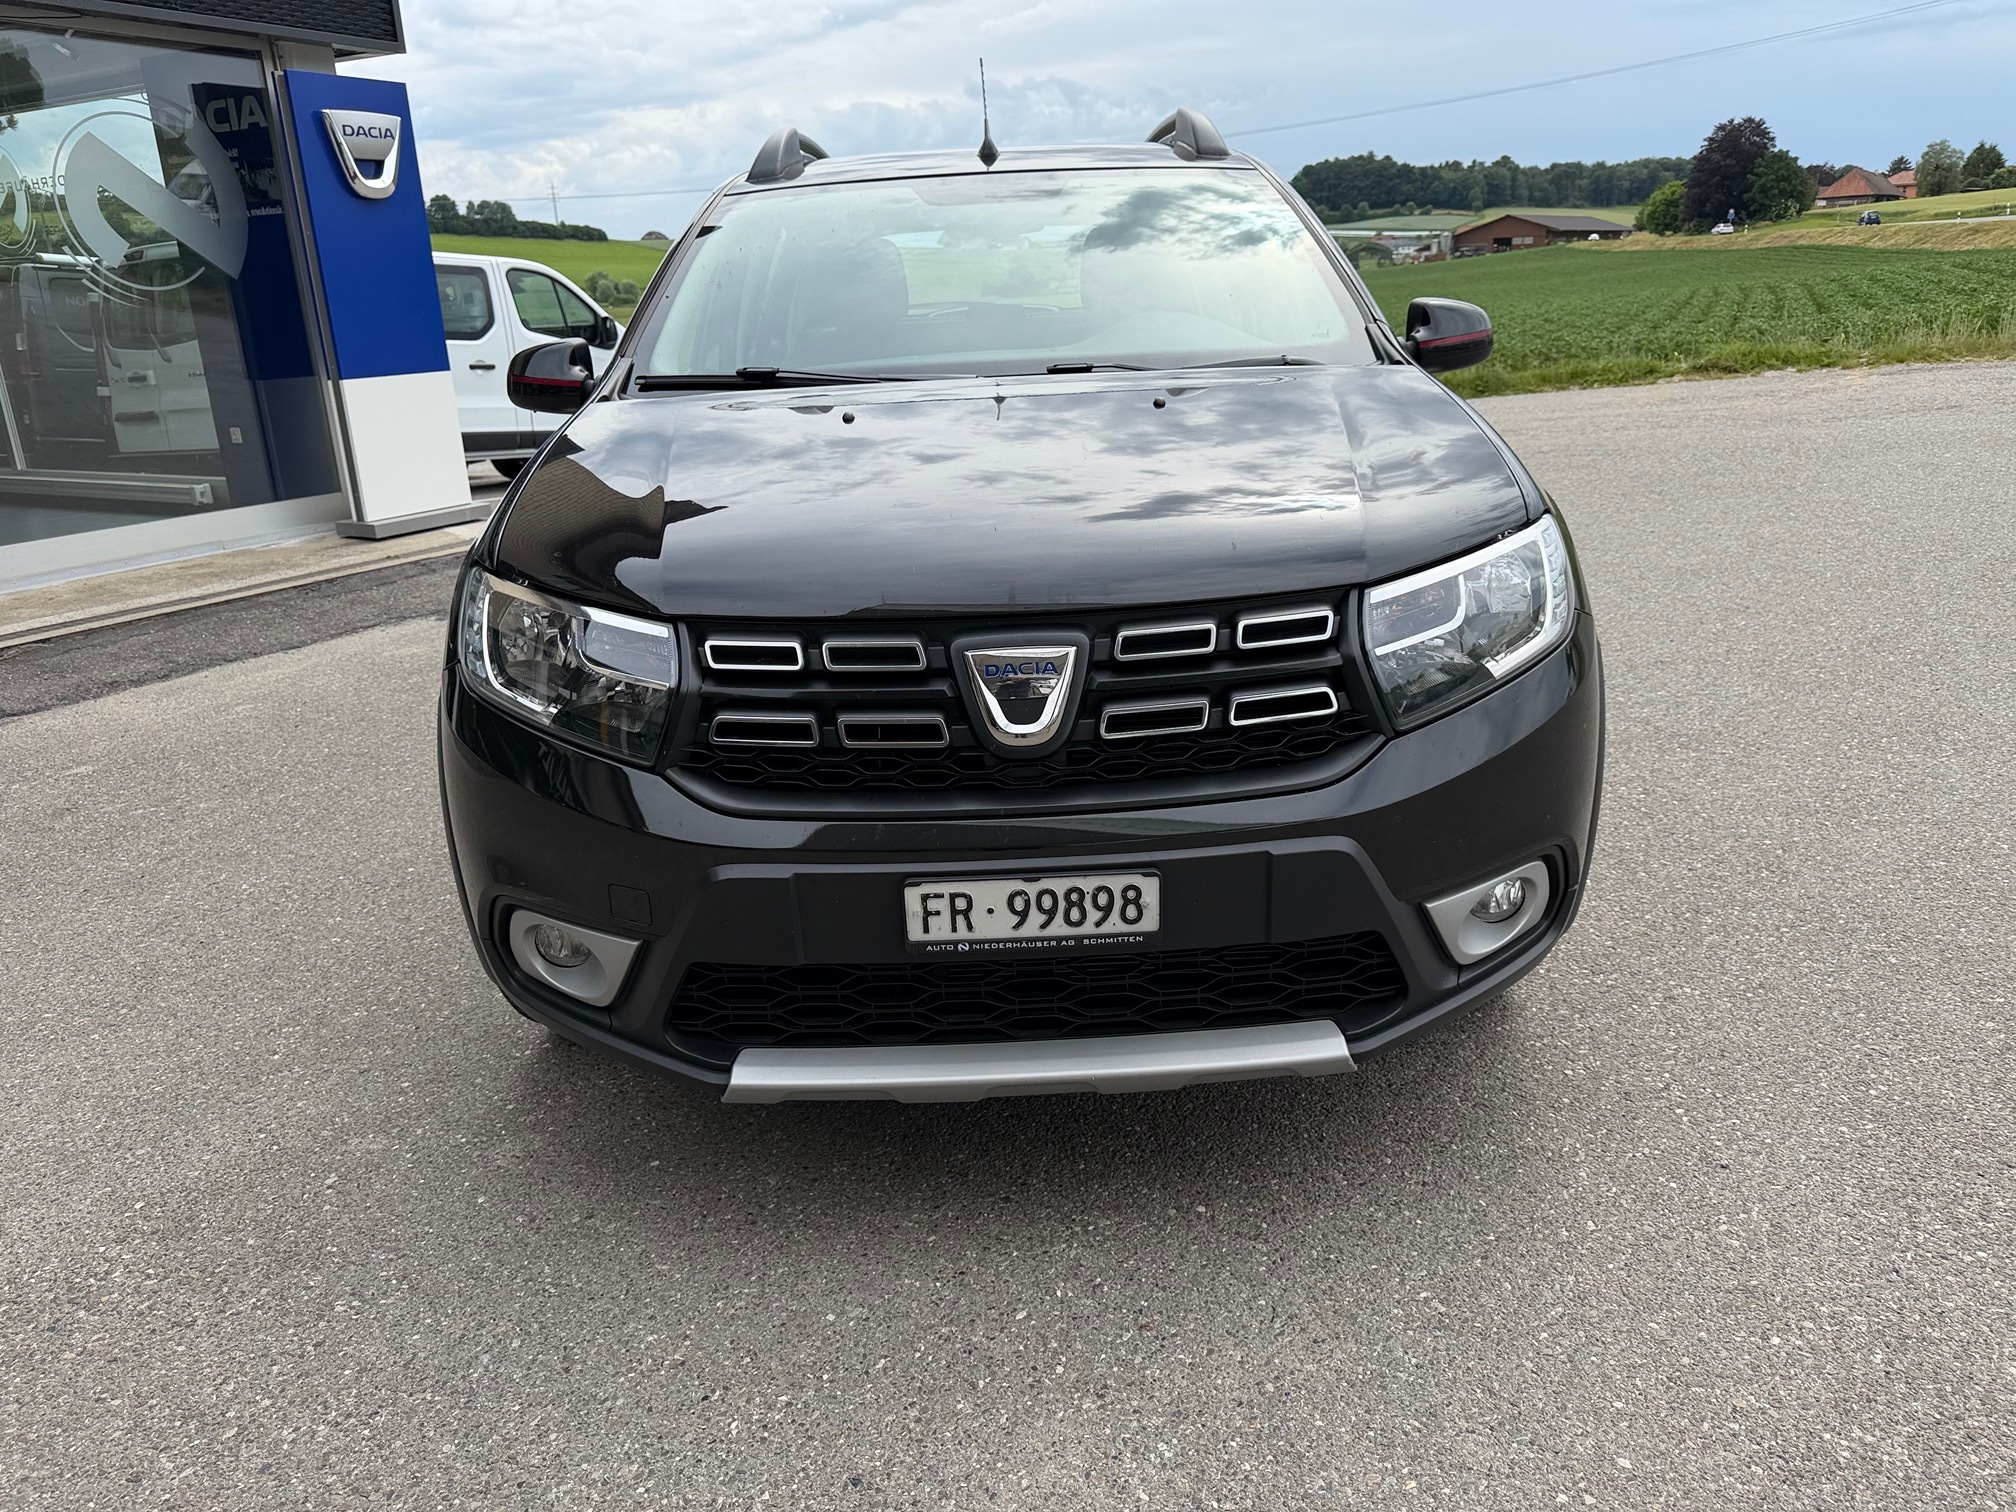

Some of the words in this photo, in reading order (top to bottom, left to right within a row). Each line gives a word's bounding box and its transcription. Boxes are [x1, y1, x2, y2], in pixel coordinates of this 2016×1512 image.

[342, 124, 395, 140] DACIA
[984, 661, 1059, 679] DACIA
[920, 891, 975, 934] FR
[1006, 883, 1144, 932] 99898
[972, 939, 1057, 950] NIEDERHÄUSER
[1060, 939, 1075, 947] AG
[1083, 936, 1144, 945] SCHMITTEN
